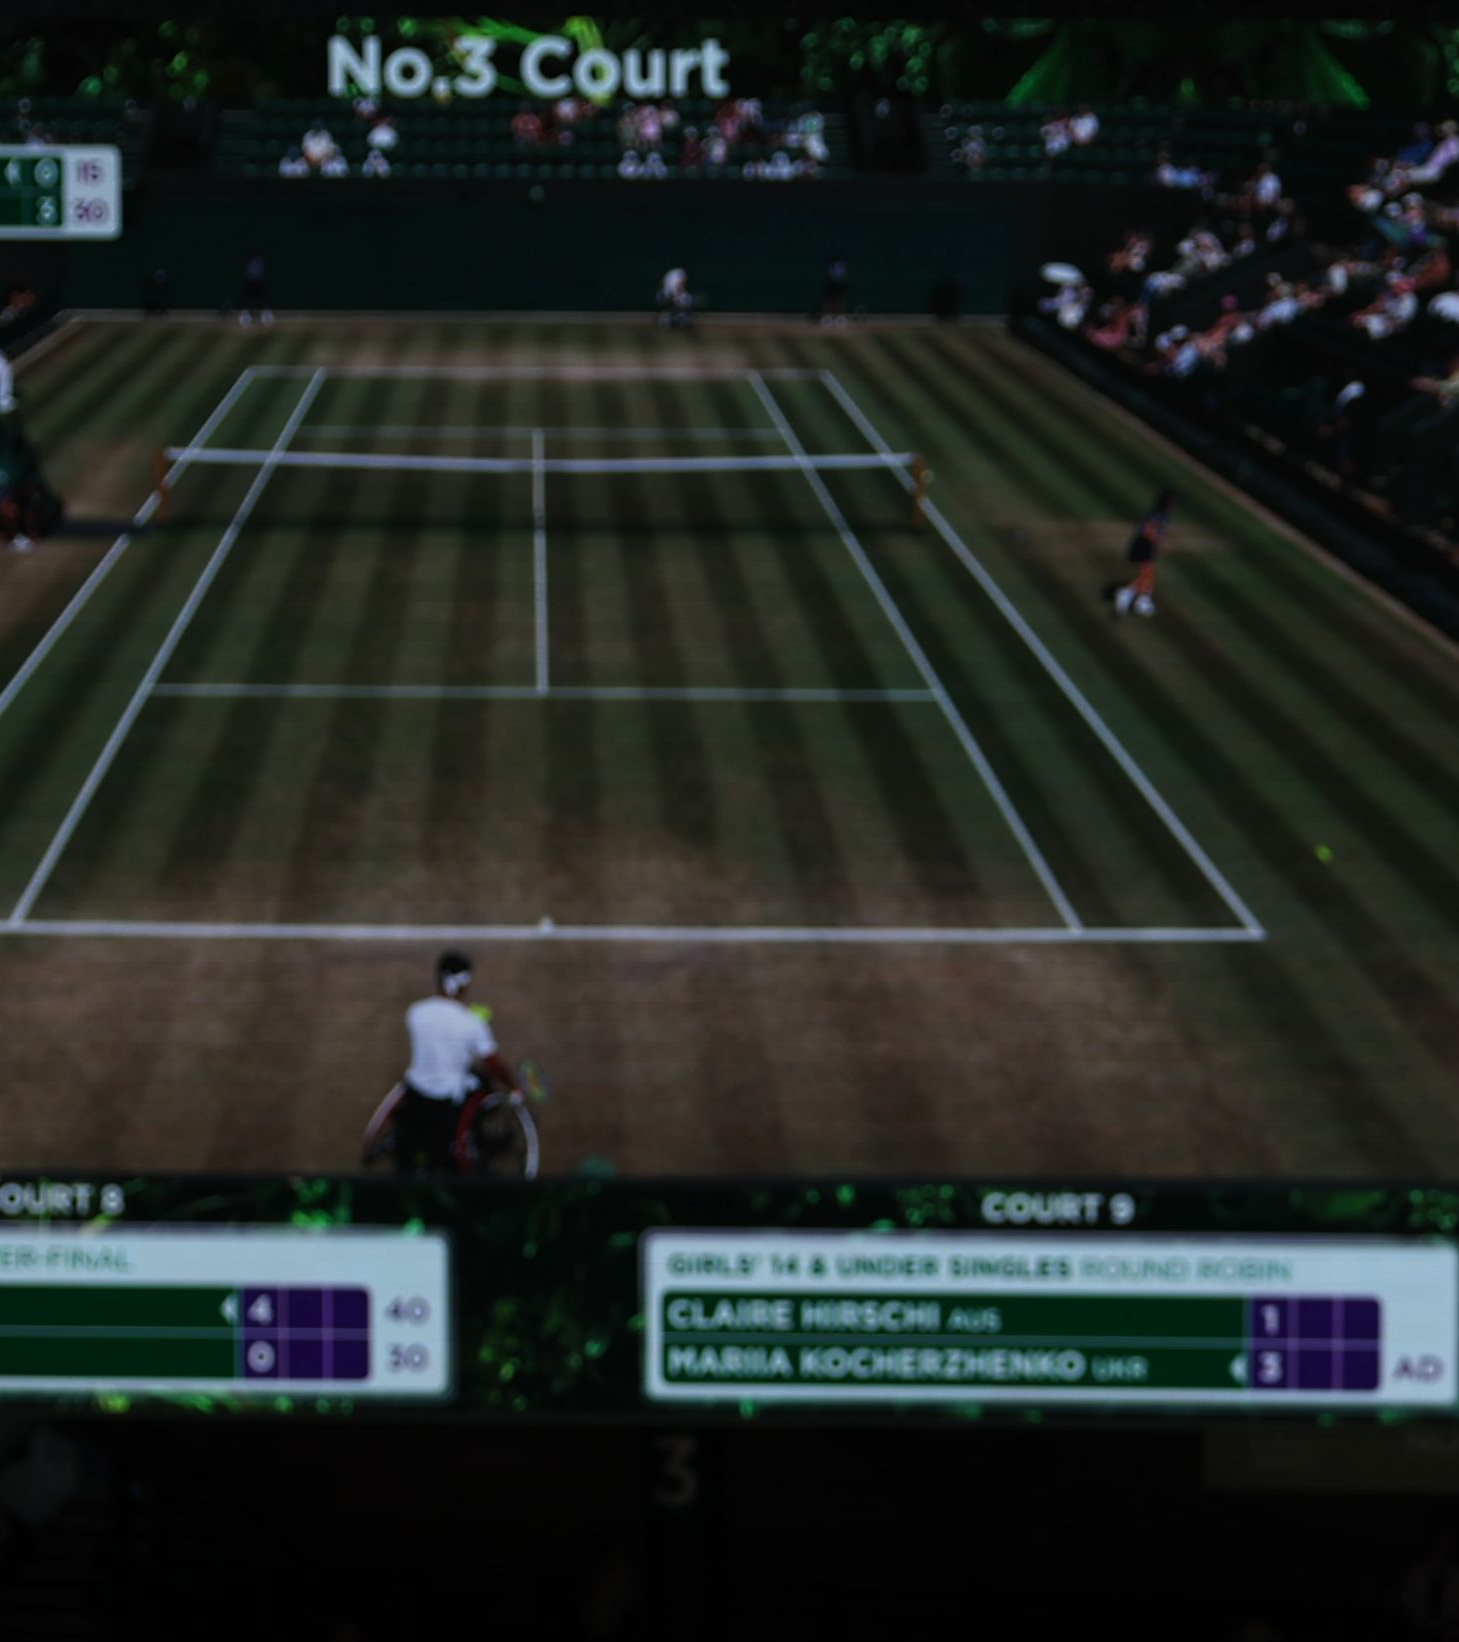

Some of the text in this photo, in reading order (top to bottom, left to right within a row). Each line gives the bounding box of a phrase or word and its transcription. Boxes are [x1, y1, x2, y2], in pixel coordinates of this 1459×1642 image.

[327, 34, 730, 98] No.3 Court
[34, 157, 59, 187] 0
[980, 1191, 1136, 1225] COURT 9
[771, 1253, 799, 1279] 14
[809, 1254, 828, 1280] &
[838, 1254, 939, 1280] UNDER
[948, 1255, 1073, 1282] SINGLES
[1080, 1257, 1191, 1283] ROUND
[1197, 1258, 1294, 1284] ROBIN
[247, 1293, 274, 1327] 4
[385, 1295, 431, 1327] 40
[666, 1299, 1281, 1337] CLAIRE HIRSCHI AUS 1
[247, 1340, 276, 1374] 0
[385, 1342, 431, 1374] 30
[666, 1345, 1445, 1385] MARIIA KOCHERZHENKO UKR 3 AD
[652, 1434, 700, 1508] 3
